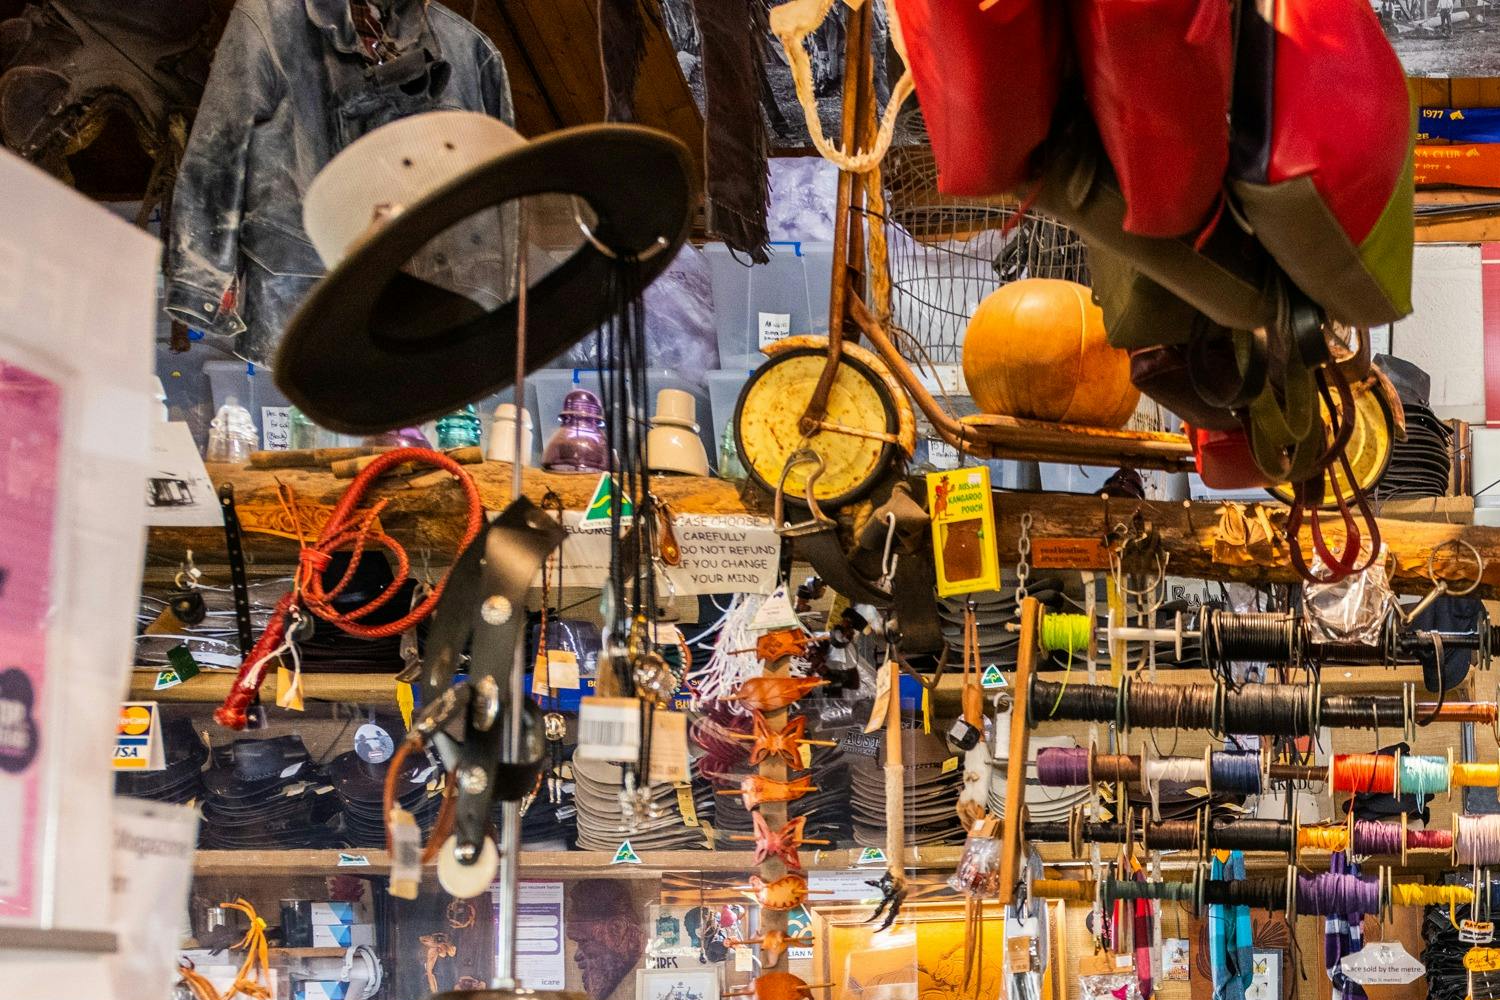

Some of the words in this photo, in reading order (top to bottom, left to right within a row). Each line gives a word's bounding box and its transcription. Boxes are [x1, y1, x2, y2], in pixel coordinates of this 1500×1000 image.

[1423, 109, 1443, 119] 1977
[948, 492, 982, 505] KANGAROO
[962, 504, 983, 514] POUCH
[711, 516, 761, 527] CHOOSE
[683, 532, 747, 541] CAREFULLY
[680, 545, 697, 555] DO
[702, 546, 727, 555] NOT
[729, 546, 776, 555] REFUND
[692, 559, 718, 568] YOU
[722, 559, 767, 569] CHANGE
[692, 574, 724, 584] YOUR
[727, 574, 759, 584] MIND
[114, 746, 138, 758] ISA
[1378, 966, 1386, 974] by
[542, 977, 560, 986] icare
